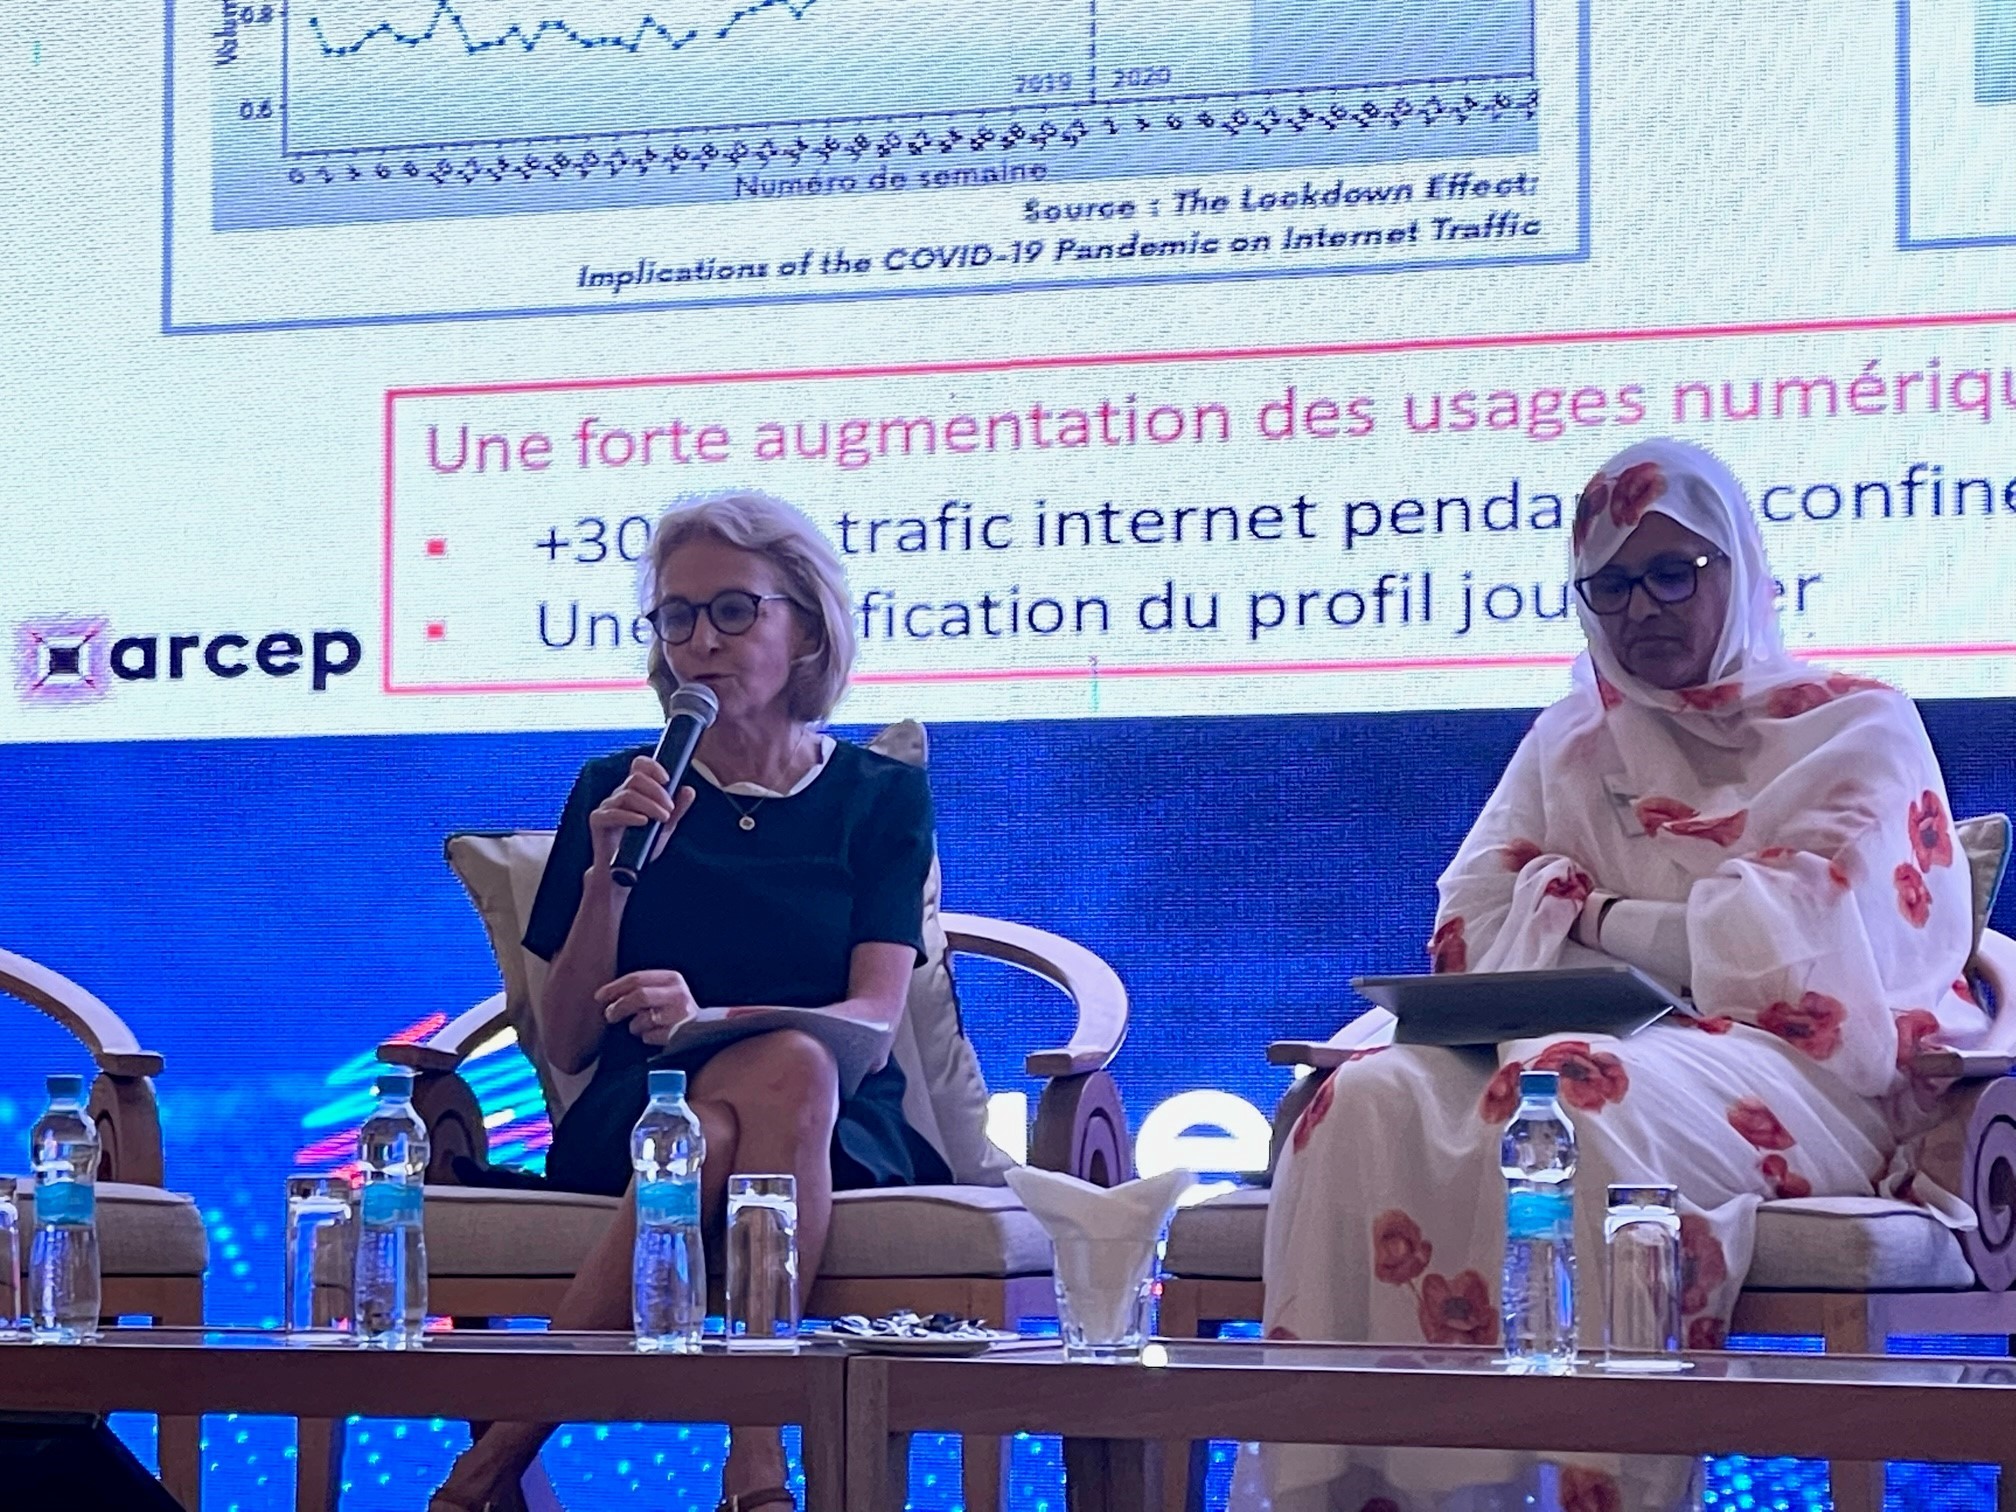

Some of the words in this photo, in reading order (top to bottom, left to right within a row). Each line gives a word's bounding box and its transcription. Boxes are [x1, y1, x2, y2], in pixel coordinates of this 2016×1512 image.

[1014, 73, 1072, 94] 2019
[1113, 68, 1171, 88] 2020
[735, 167, 855, 200] Numéro
[869, 164, 905, 192] de
[919, 161, 1048, 189] semaine
[1023, 197, 1135, 224] Source
[1174, 188, 1230, 215] The
[1240, 180, 1413, 212] Lockdown
[577, 258, 769, 294] Implications
[780, 248, 813, 278] of
[820, 248, 872, 275] the
[884, 241, 1044, 273] COVID-19
[1054, 229, 1218, 262] Pandemic
[1230, 229, 1271, 254] on
[1283, 223, 1419, 252] Internet
[1433, 215, 1541, 242] Traffic
[427, 424, 552, 474] Une
[573, 416, 731, 468] forte
[755, 392, 1230, 469] augmentation
[1259, 384, 1375, 442] des
[1405, 383, 1646, 442] usages
[837, 502, 1012, 555] trafic
[1036, 496, 1318, 547] internet
[1346, 478, 1578, 550] penda
[857, 584, 1109, 639] fication
[1139, 580, 1218, 631] du
[1252, 574, 1432, 640] profil
[110, 628, 363, 691] arcep
